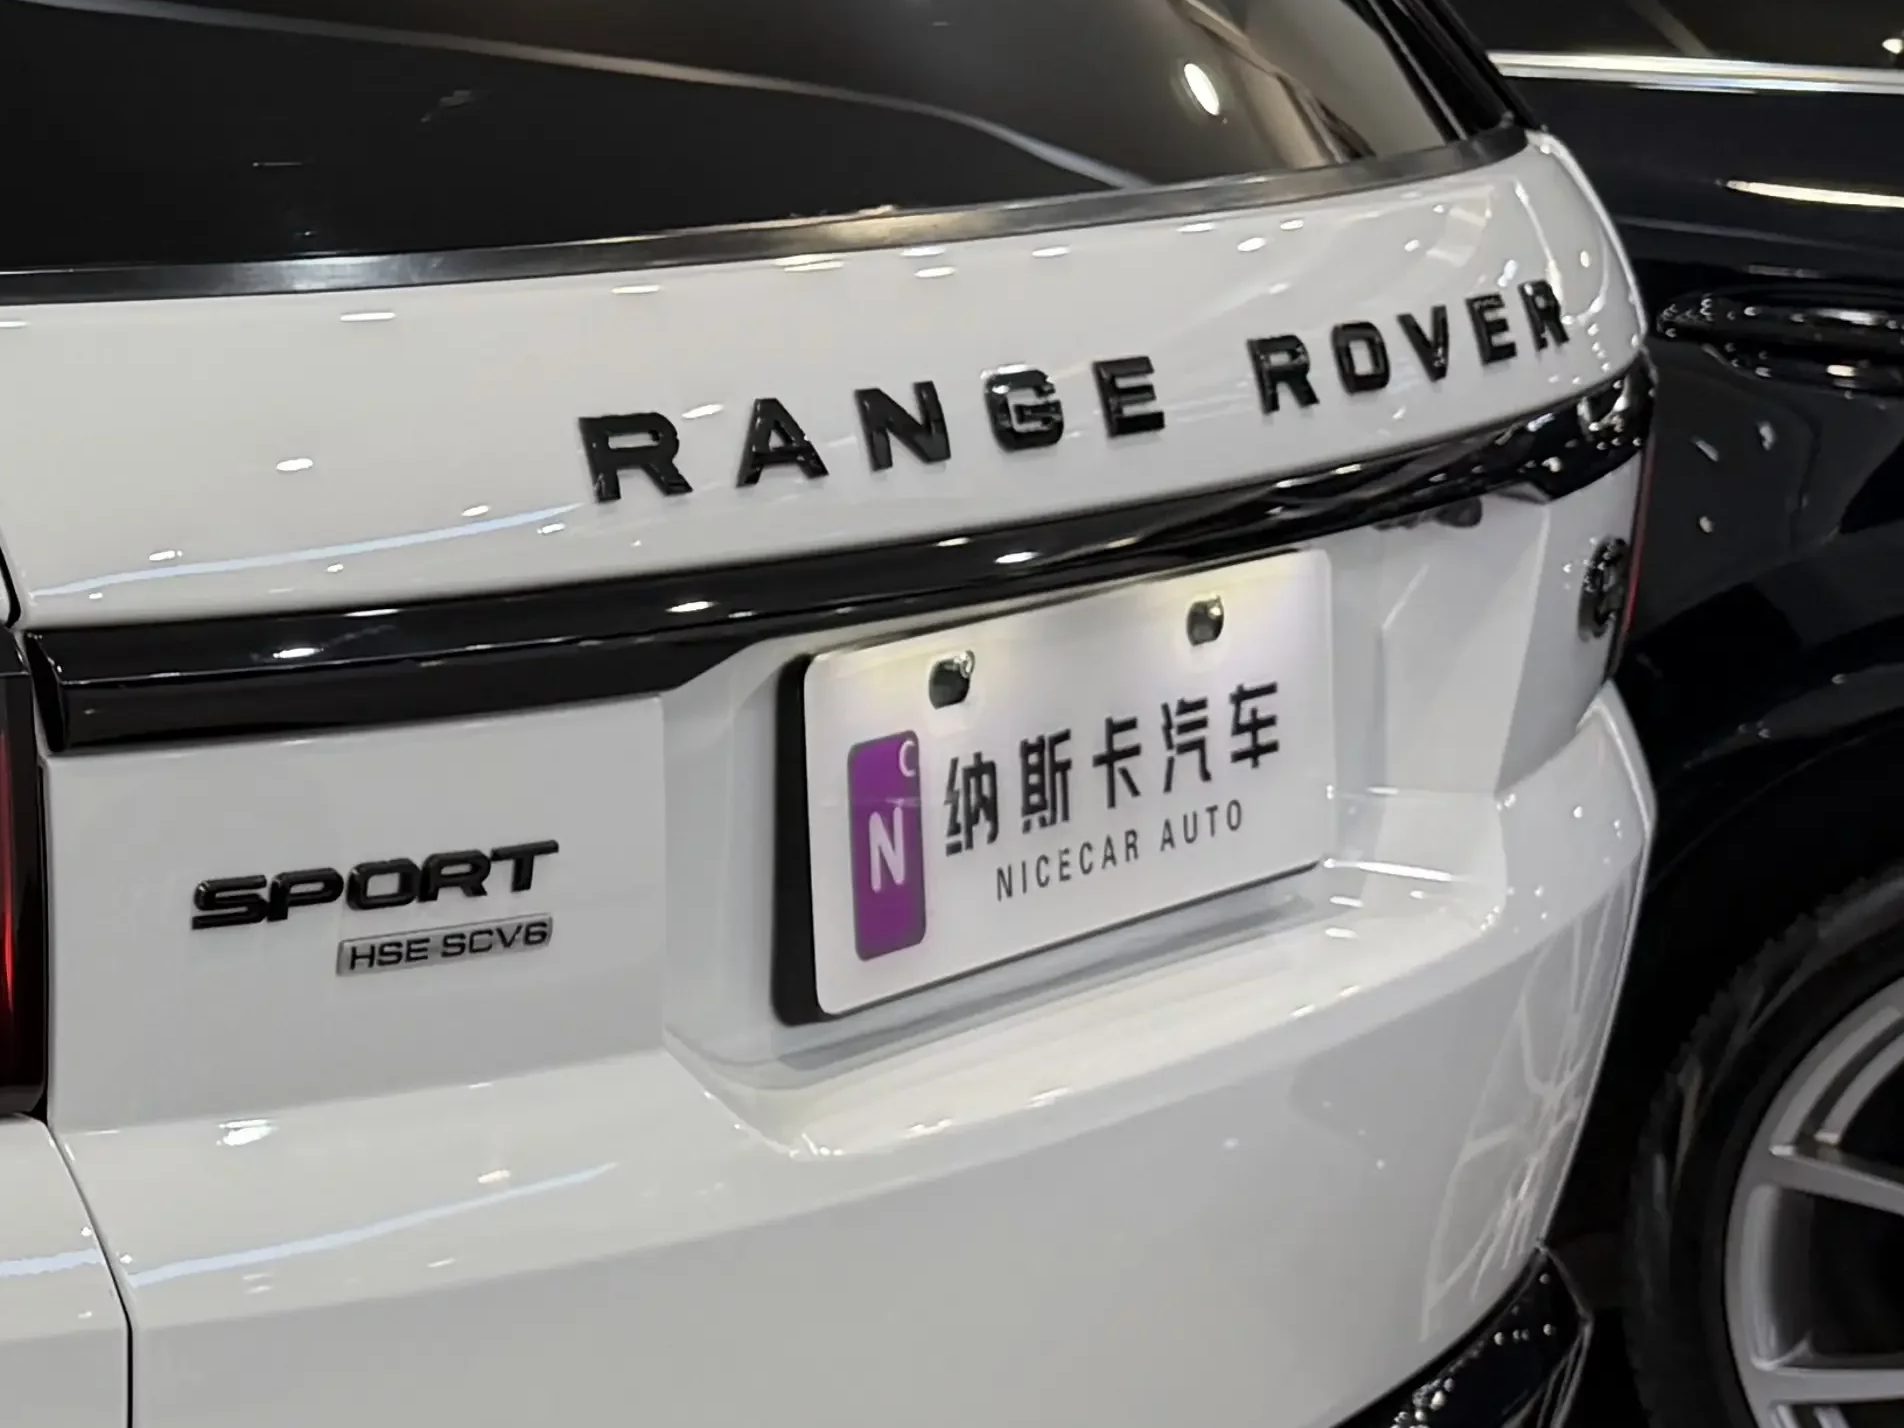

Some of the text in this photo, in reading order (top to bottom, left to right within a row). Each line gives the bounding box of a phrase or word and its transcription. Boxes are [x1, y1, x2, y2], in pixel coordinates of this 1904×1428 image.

[579, 280, 1570, 503] RANGE ROVER
[944, 681, 1280, 857] 纳斯卡汽车
[192, 839, 560, 930] SPORT
[869, 805, 906, 893] N
[996, 799, 1243, 902] NICECAR AUTO
[349, 921, 550, 971] HSE SCV6
